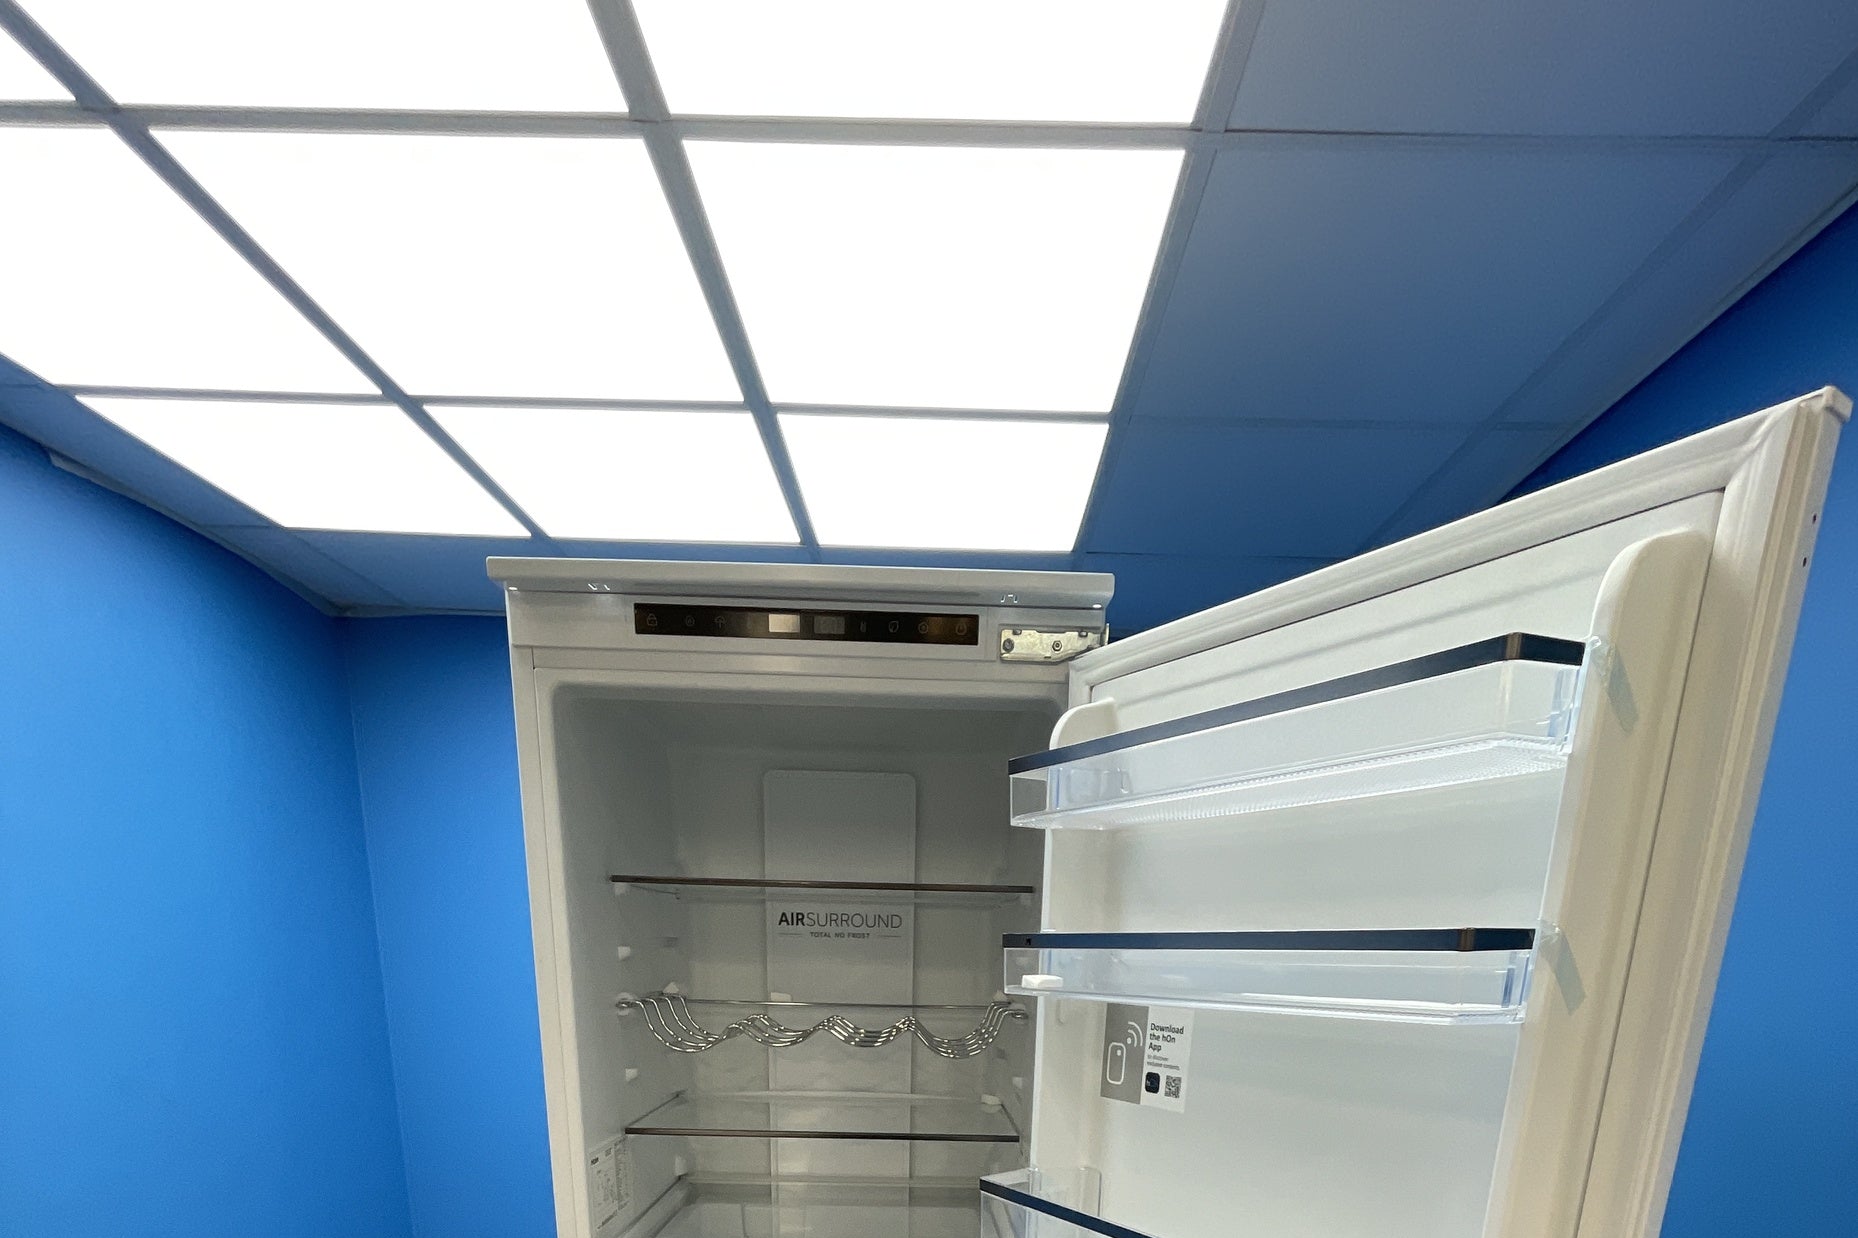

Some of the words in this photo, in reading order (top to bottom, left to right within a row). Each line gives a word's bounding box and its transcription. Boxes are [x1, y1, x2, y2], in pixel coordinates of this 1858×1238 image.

[777, 911, 903, 929] AIRSURROUND
[1150, 1022, 1185, 1035] Download
[1149, 1032, 1161, 1041] the
[1161, 1034, 1176, 1043] hOn
[1148, 1042, 1162, 1053] App
